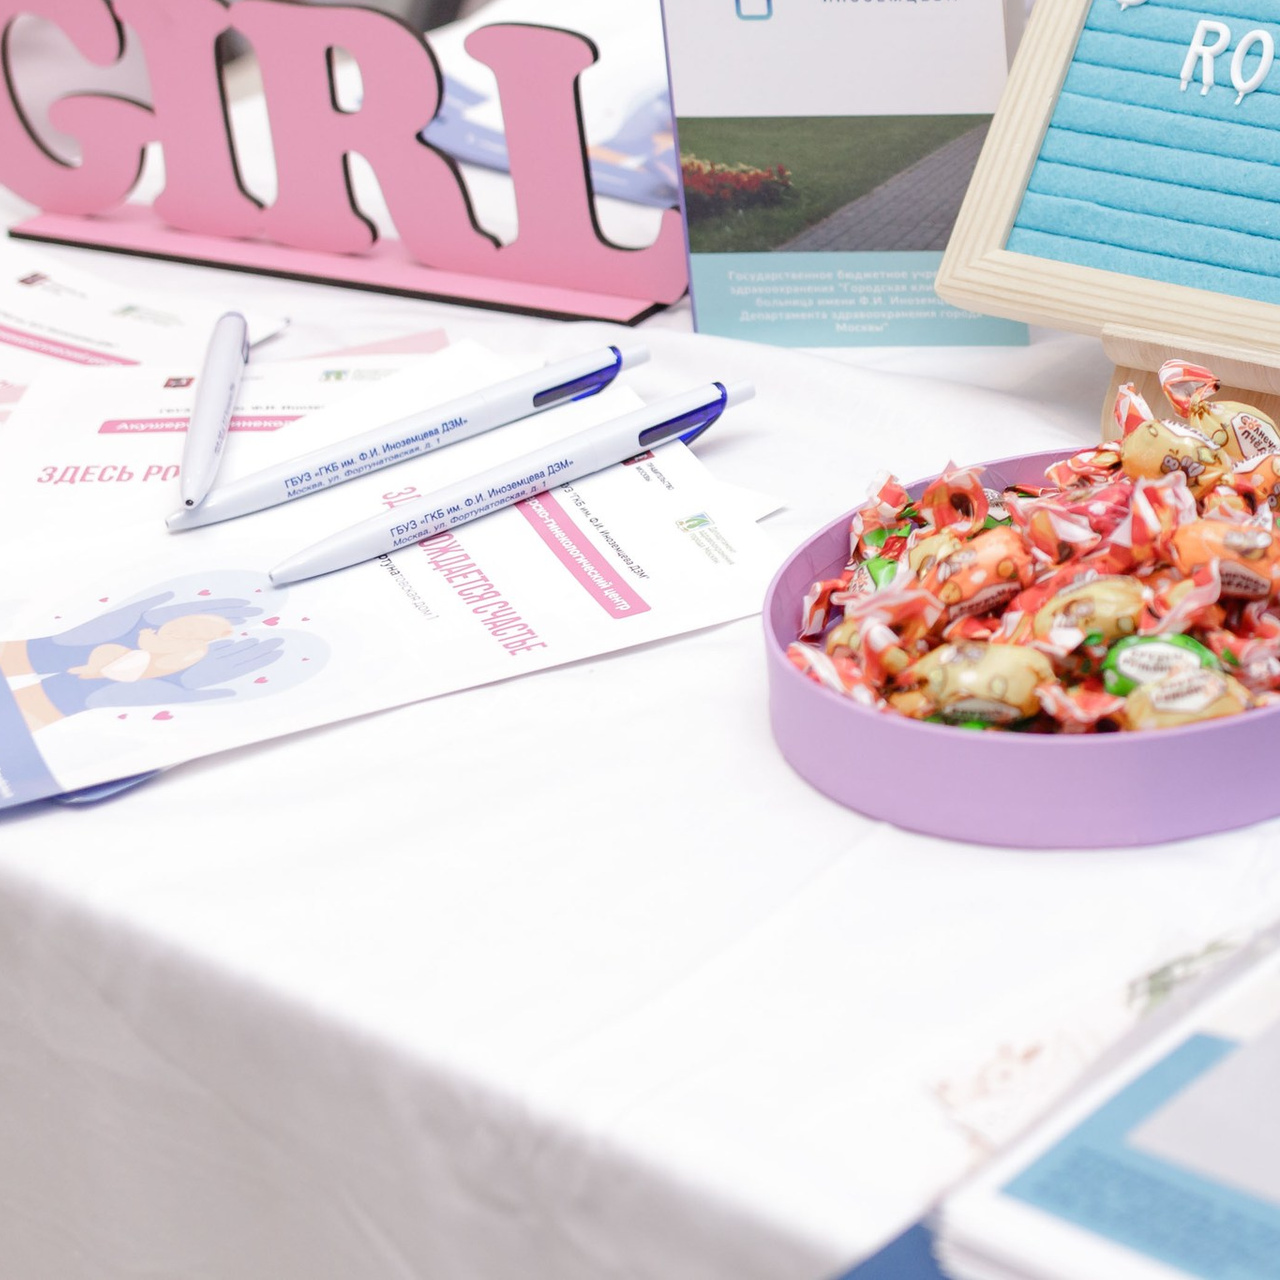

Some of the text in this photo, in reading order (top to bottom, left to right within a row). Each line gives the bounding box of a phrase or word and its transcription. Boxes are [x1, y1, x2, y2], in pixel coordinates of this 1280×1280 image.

[37, 464, 135, 485] ЗДЕСЬ
[284, 472, 312, 489] ГБУЗ
[382, 426, 440, 454] Иноземцева
[390, 521, 418, 538] ГБУЗ
[487, 470, 546, 501] Иноземцева
[418, 530, 548, 657] ОЖДАЕТСЯ СЧАСТЬЕ
[603, 587, 632, 611] центр
